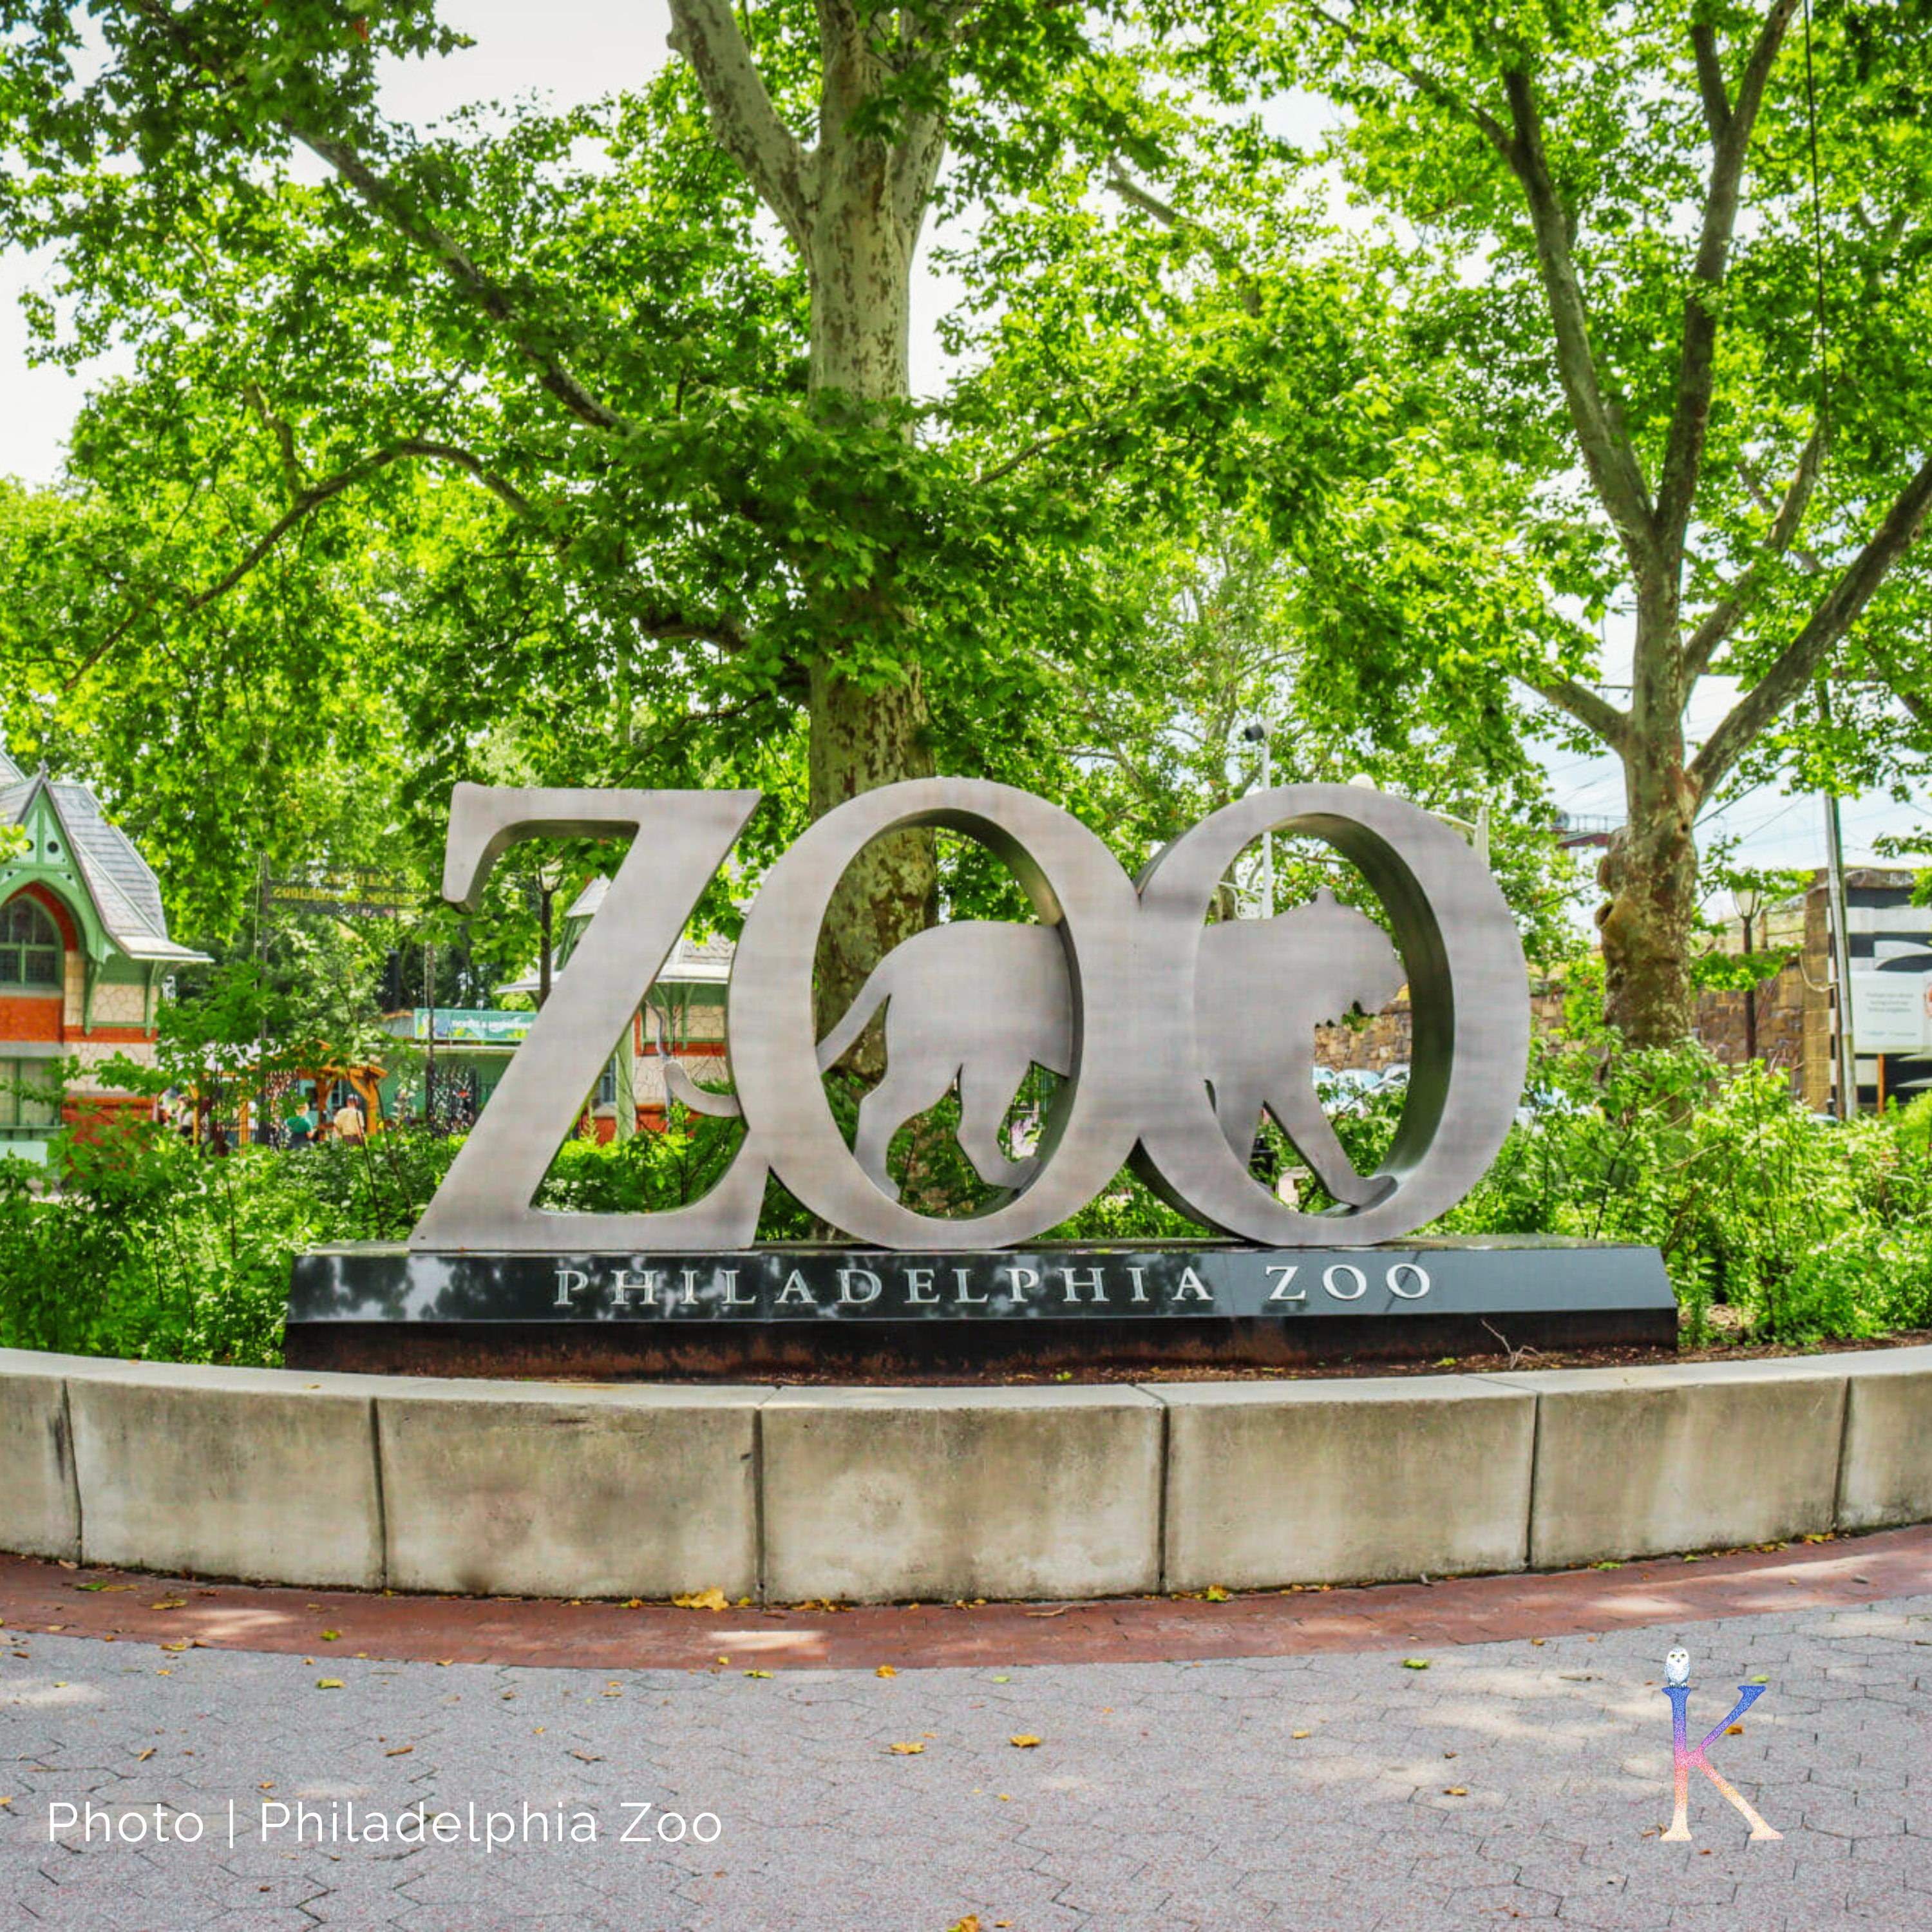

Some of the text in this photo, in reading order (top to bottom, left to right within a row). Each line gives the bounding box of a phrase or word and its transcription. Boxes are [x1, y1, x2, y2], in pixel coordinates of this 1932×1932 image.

[408, 777, 1530, 1251] ZOO
[553, 1262, 1430, 1305] PHILADELPHIA ZOO
